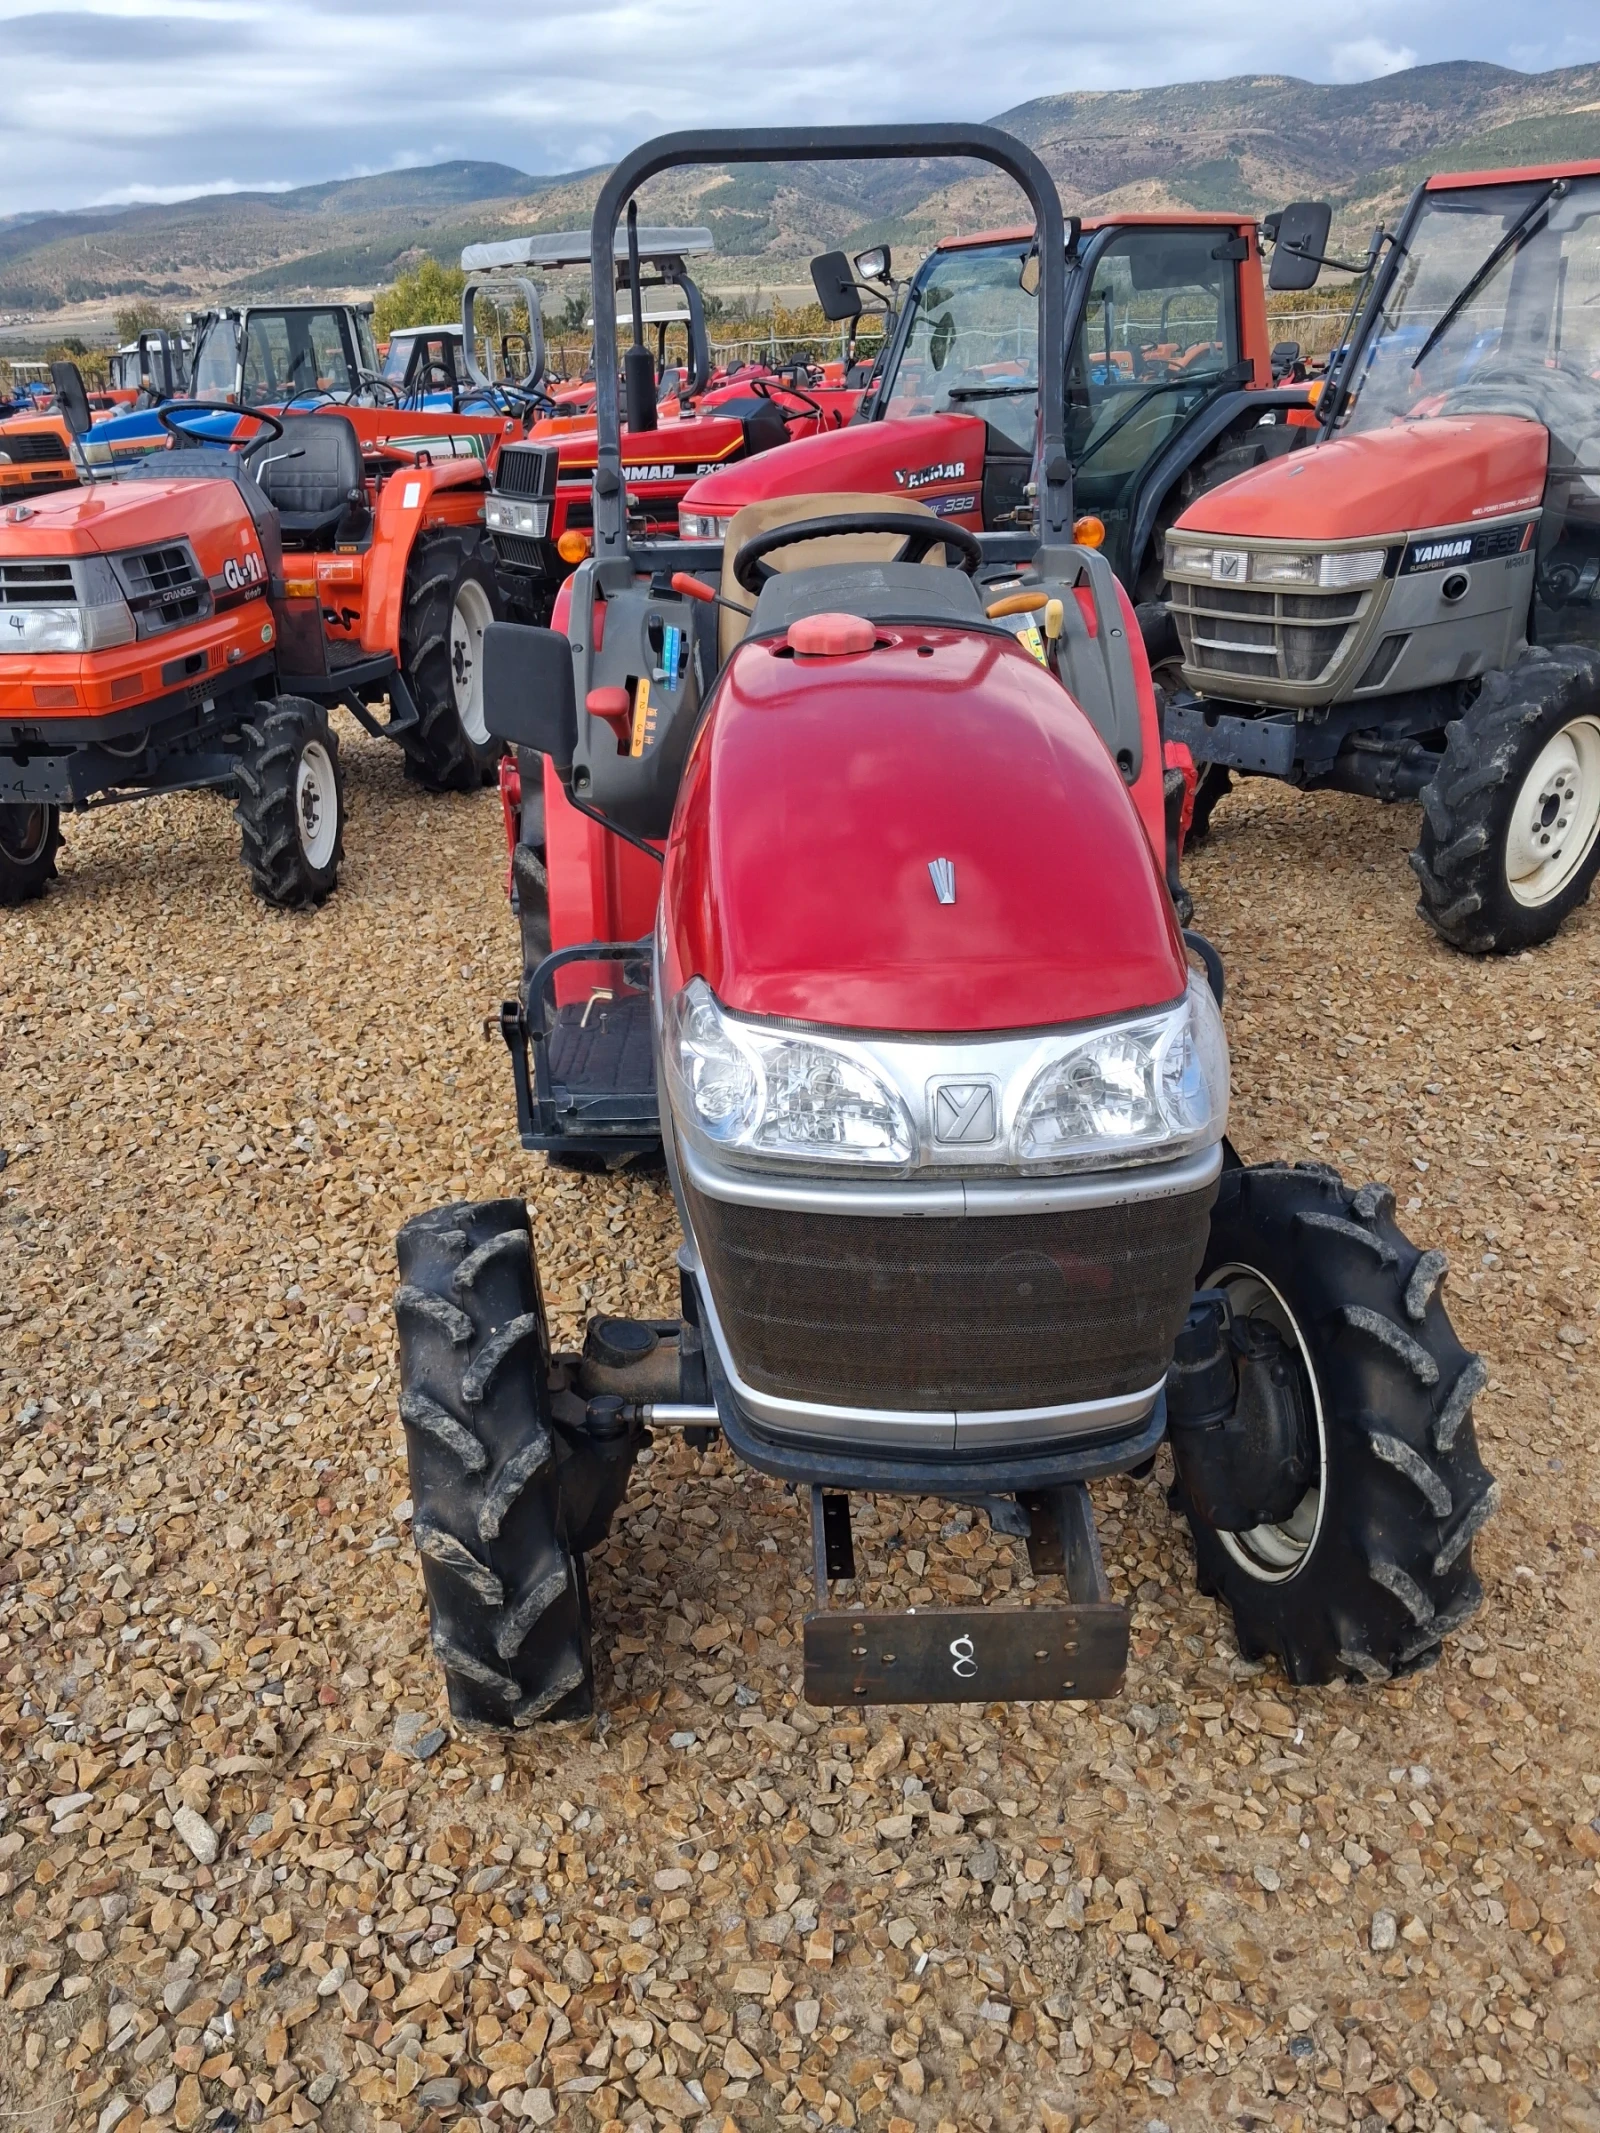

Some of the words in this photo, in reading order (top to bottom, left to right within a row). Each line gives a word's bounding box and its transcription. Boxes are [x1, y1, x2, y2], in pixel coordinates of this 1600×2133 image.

[592, 464, 675, 481] NMAR
[944, 496, 975, 512] 333
[1415, 540, 1471, 563] YANMAR
[224, 552, 262, 590] GL-21
[162, 585, 196, 602] GRANDEL
[9, 614, 25, 637] 4
[639, 701, 646, 710] 2
[636, 723, 643, 733] 3
[635, 738, 642, 747] 4
[12, 780, 37, 801] 4
[949, 1633, 978, 1678] 8
